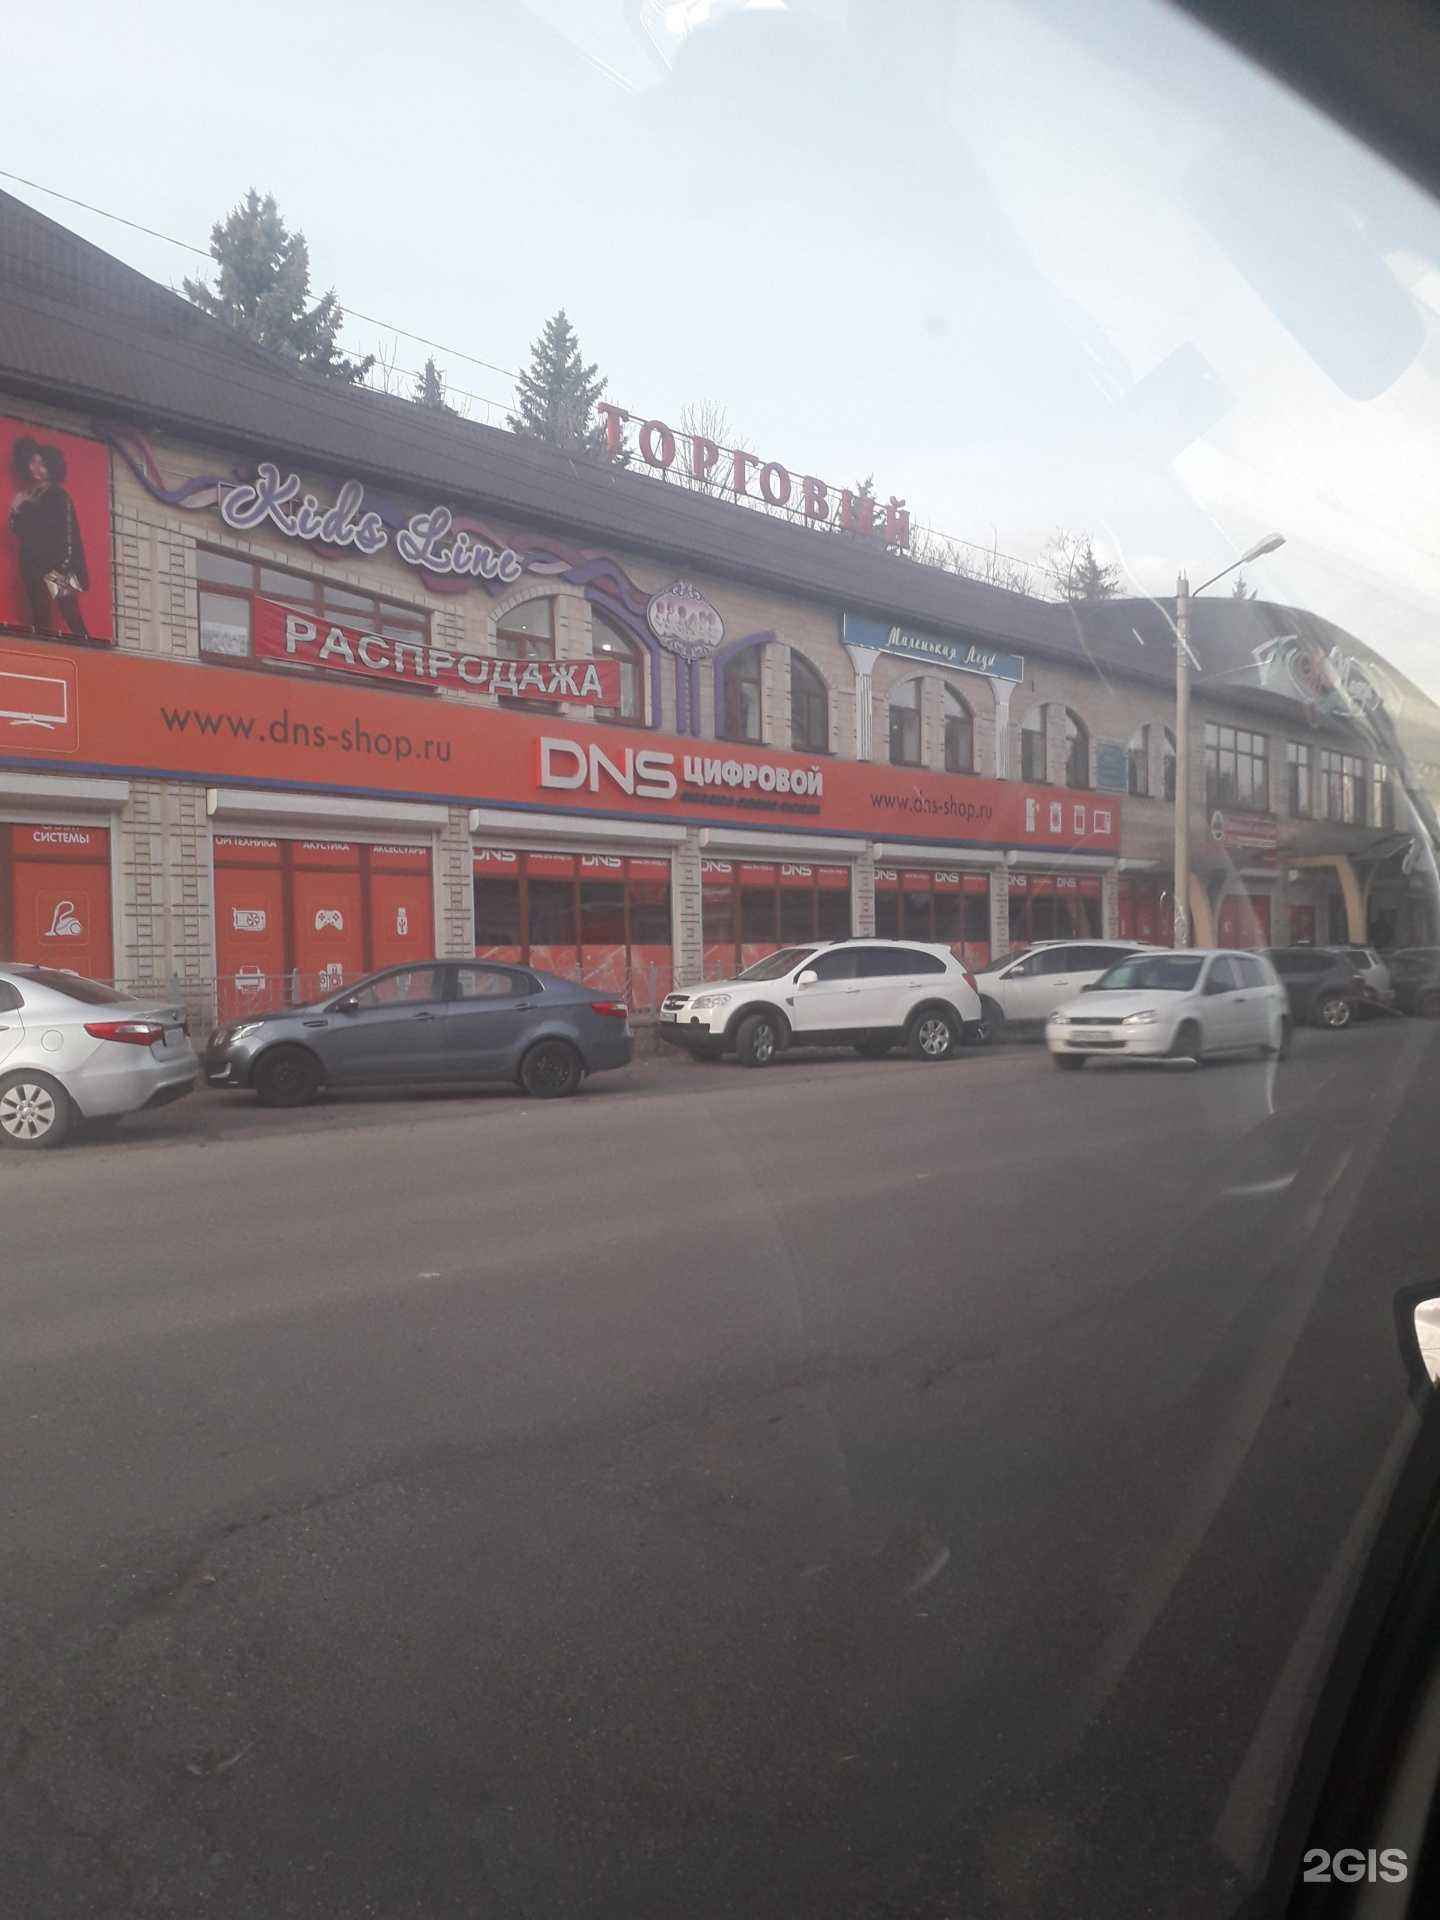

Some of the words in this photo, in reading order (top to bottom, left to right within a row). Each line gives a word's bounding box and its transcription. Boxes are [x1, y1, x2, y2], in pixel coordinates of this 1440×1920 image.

[598, 401, 910, 549] ТОРГОВЫЙ
[221, 463, 386, 554] Kids
[397, 506, 522, 582] Line
[285, 613, 606, 697] РАСПРОДАЖА
[160, 707, 452, 762] www.dns-shop.ru
[540, 736, 678, 799] DNS
[683, 755, 824, 797] ЦИФРОВОЙ
[871, 791, 992, 822] www.dns-shop.ru
[33, 831, 89, 844] СИСТЕМЫ
[781, 863, 812, 876] DNS
[935, 870, 960, 883] DNS
